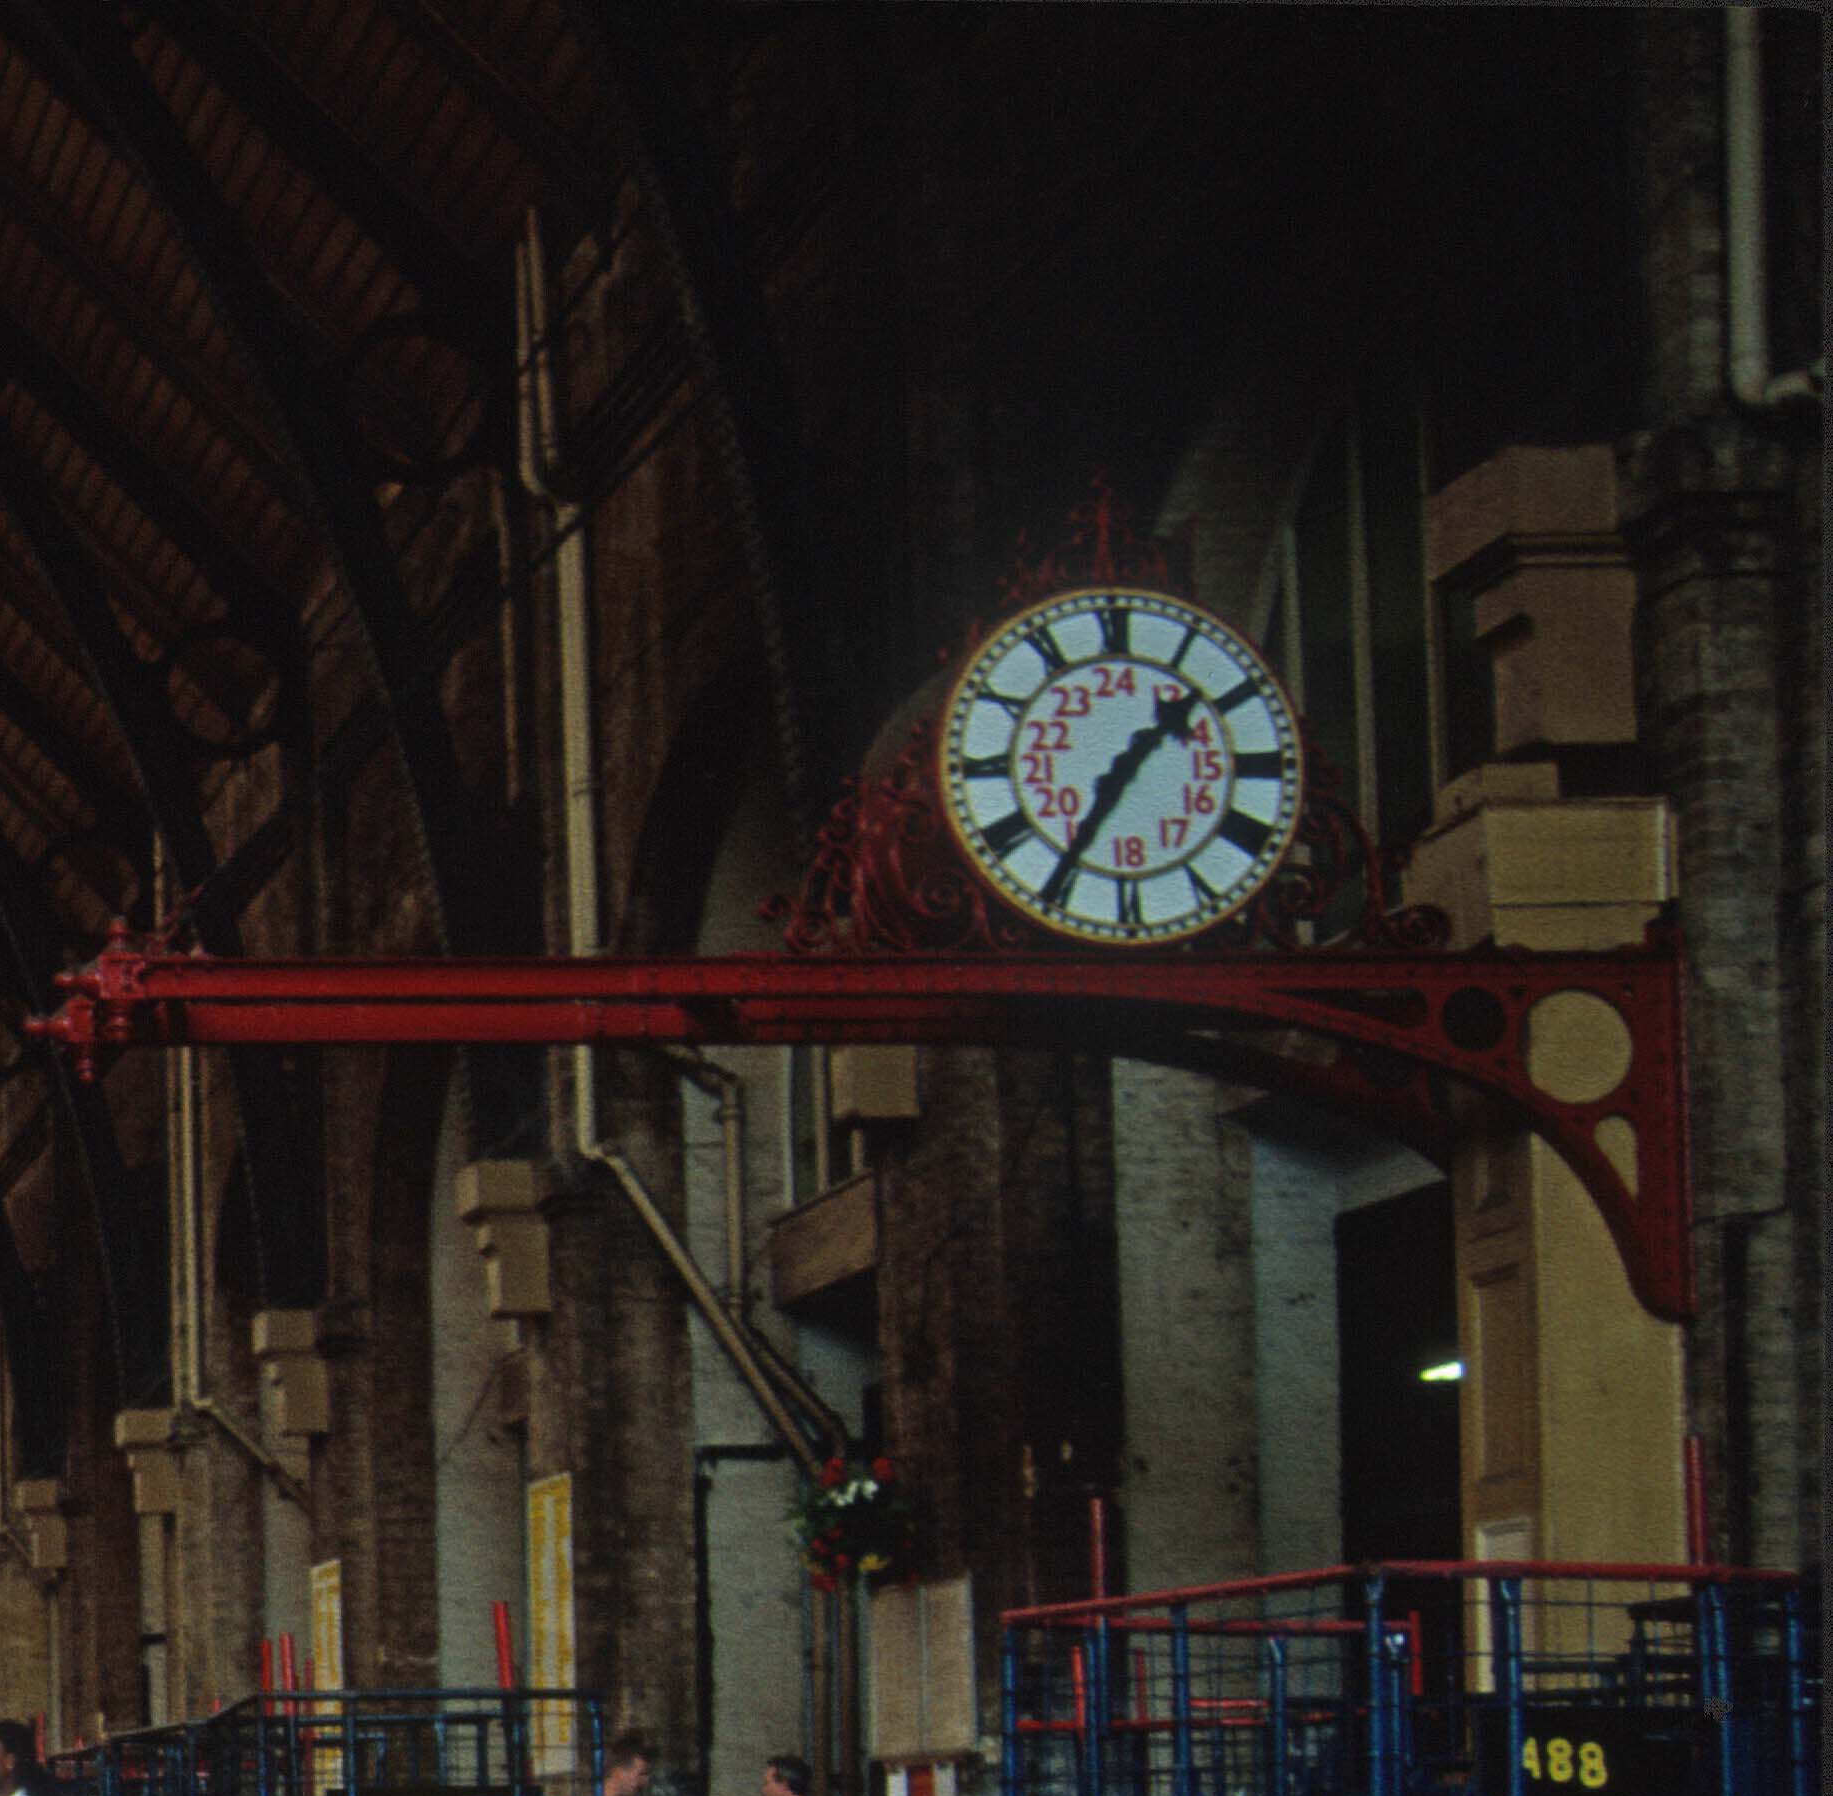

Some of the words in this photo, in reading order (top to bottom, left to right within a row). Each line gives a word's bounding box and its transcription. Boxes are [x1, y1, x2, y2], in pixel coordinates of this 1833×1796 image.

[1093, 667, 1136, 698] 24
[1051, 686, 1092, 718] 23
[1027, 720, 1072, 751] 22
[1180, 717, 1212, 747] 4
[1022, 752, 1053, 784] 21
[1192, 750, 1224, 781] 15
[1036, 786, 1081, 818] 20
[1183, 782, 1215, 815] 16
[1158, 817, 1189, 849] 17
[1113, 835, 1146, 868] 18
